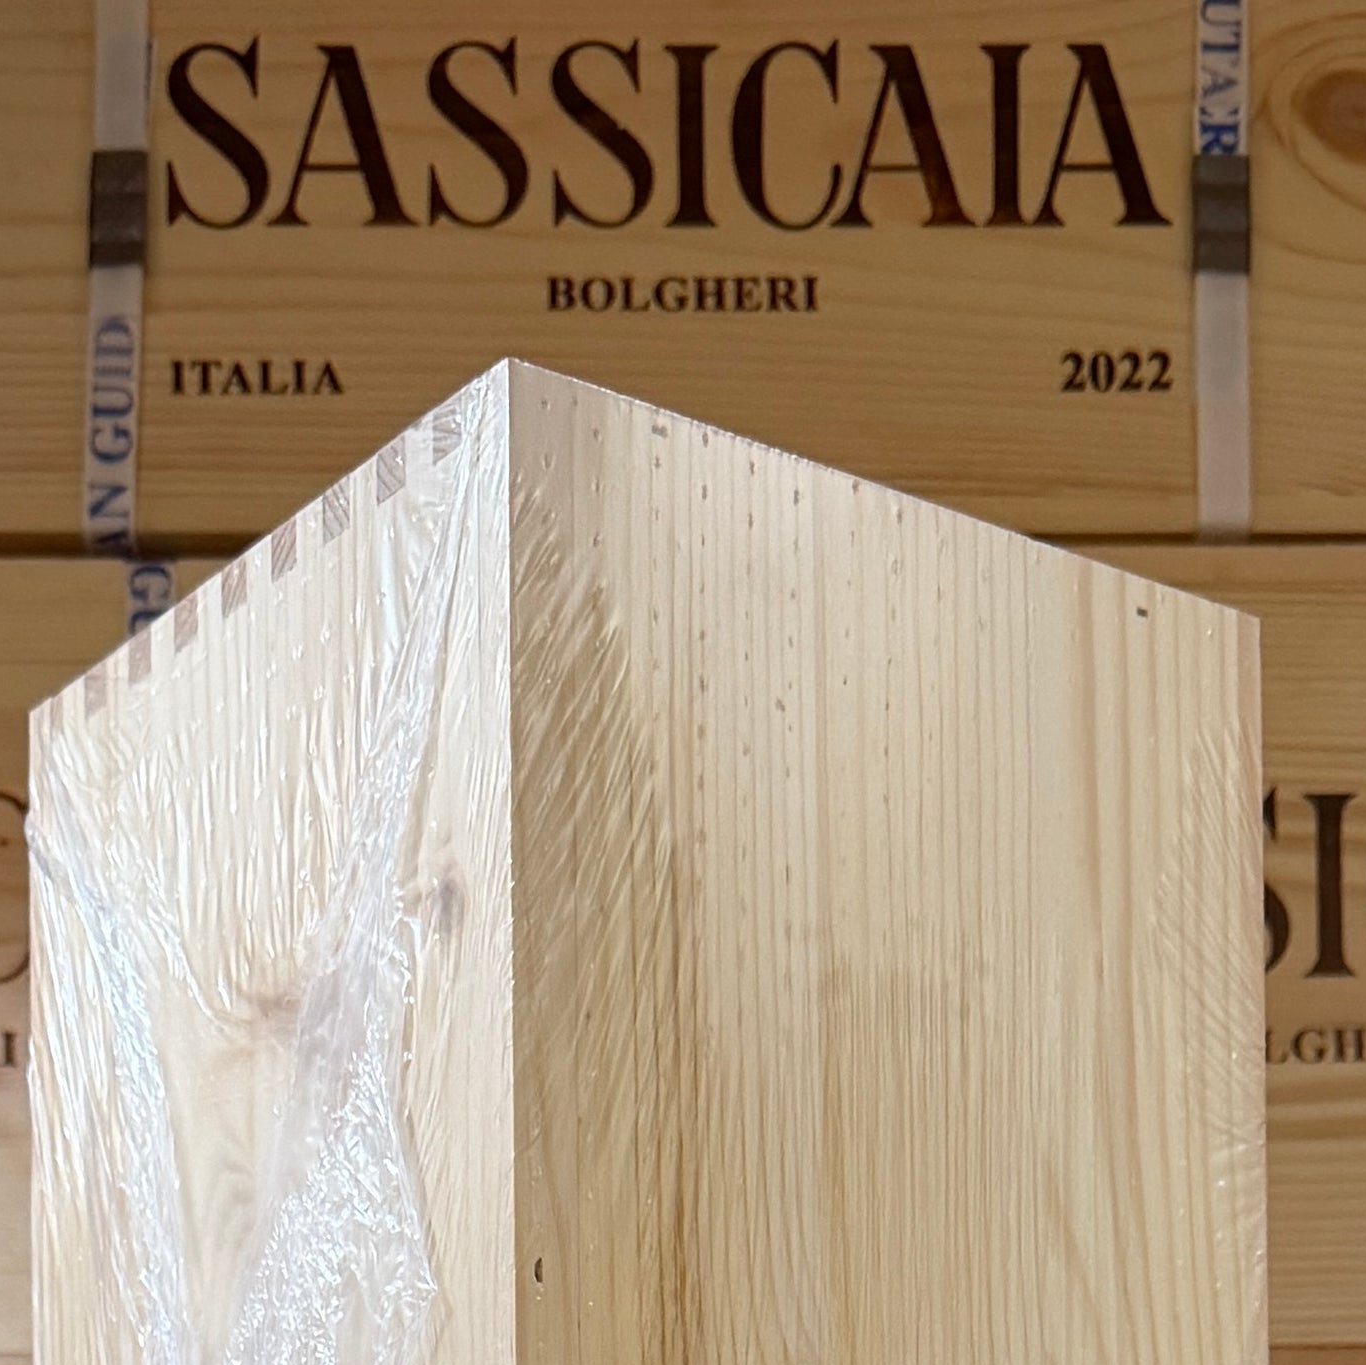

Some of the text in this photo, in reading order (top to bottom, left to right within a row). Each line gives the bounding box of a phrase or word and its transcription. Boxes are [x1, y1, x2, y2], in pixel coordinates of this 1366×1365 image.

[165, 35, 1172, 230] SASSICAIA
[547, 276, 819, 313] BOLGHERI
[171, 350, 1173, 396] ITALIA 2022
